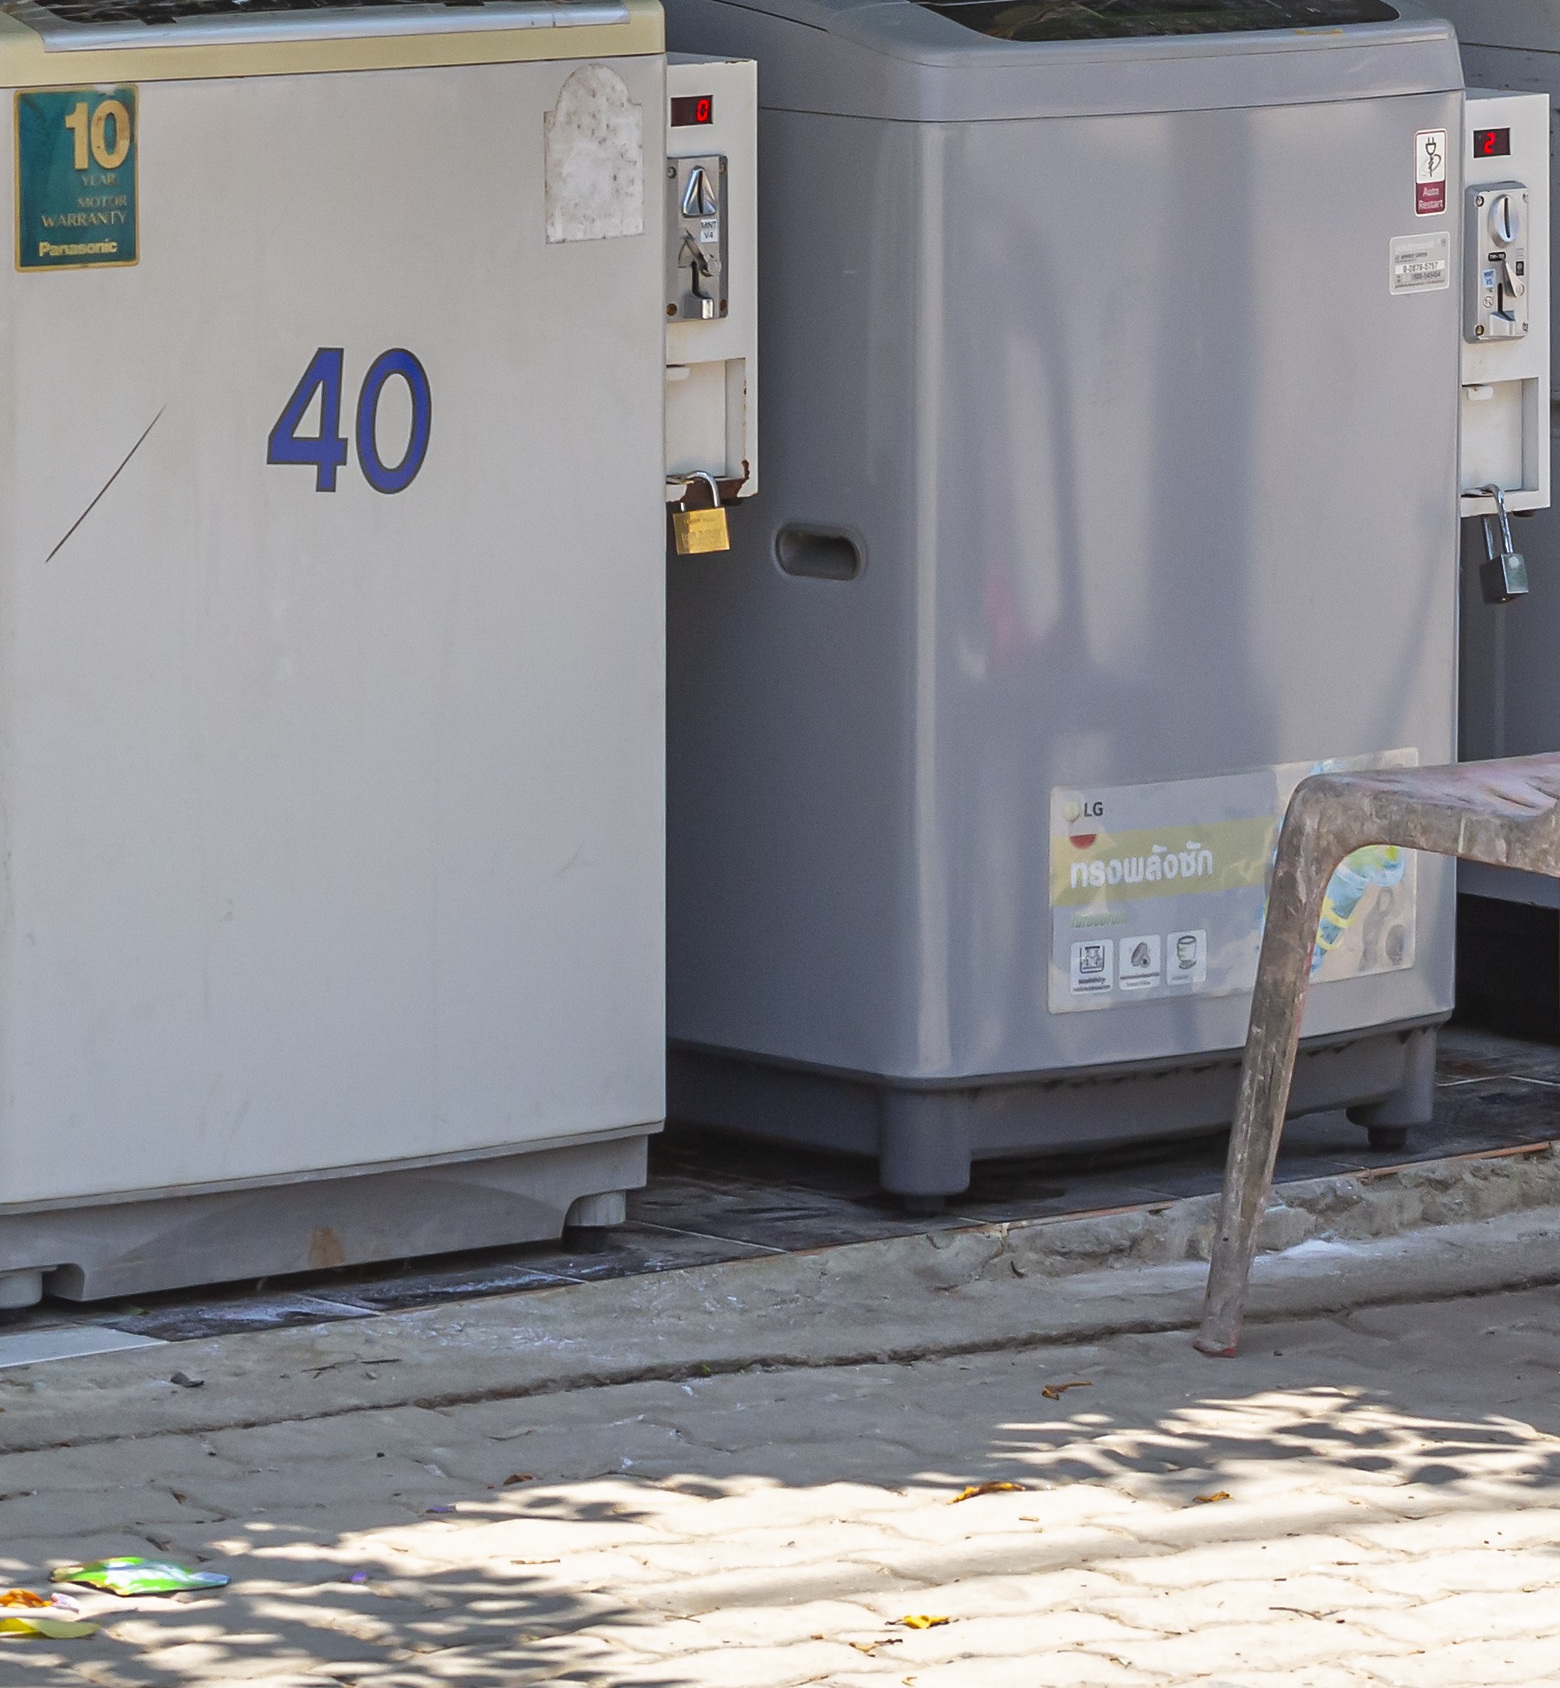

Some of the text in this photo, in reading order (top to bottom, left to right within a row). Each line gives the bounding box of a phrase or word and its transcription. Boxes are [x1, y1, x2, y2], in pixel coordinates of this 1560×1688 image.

[696, 98, 710, 123] 0
[65, 99, 131, 170] 10
[1483, 131, 1496, 155] 2
[41, 211, 127, 228] WARRANTY
[39, 239, 118, 257] Panasonic
[266, 346, 432, 495] 40
[1083, 801, 1104, 818] LG
[1070, 840, 1214, 889] ทรงพลังซัก
